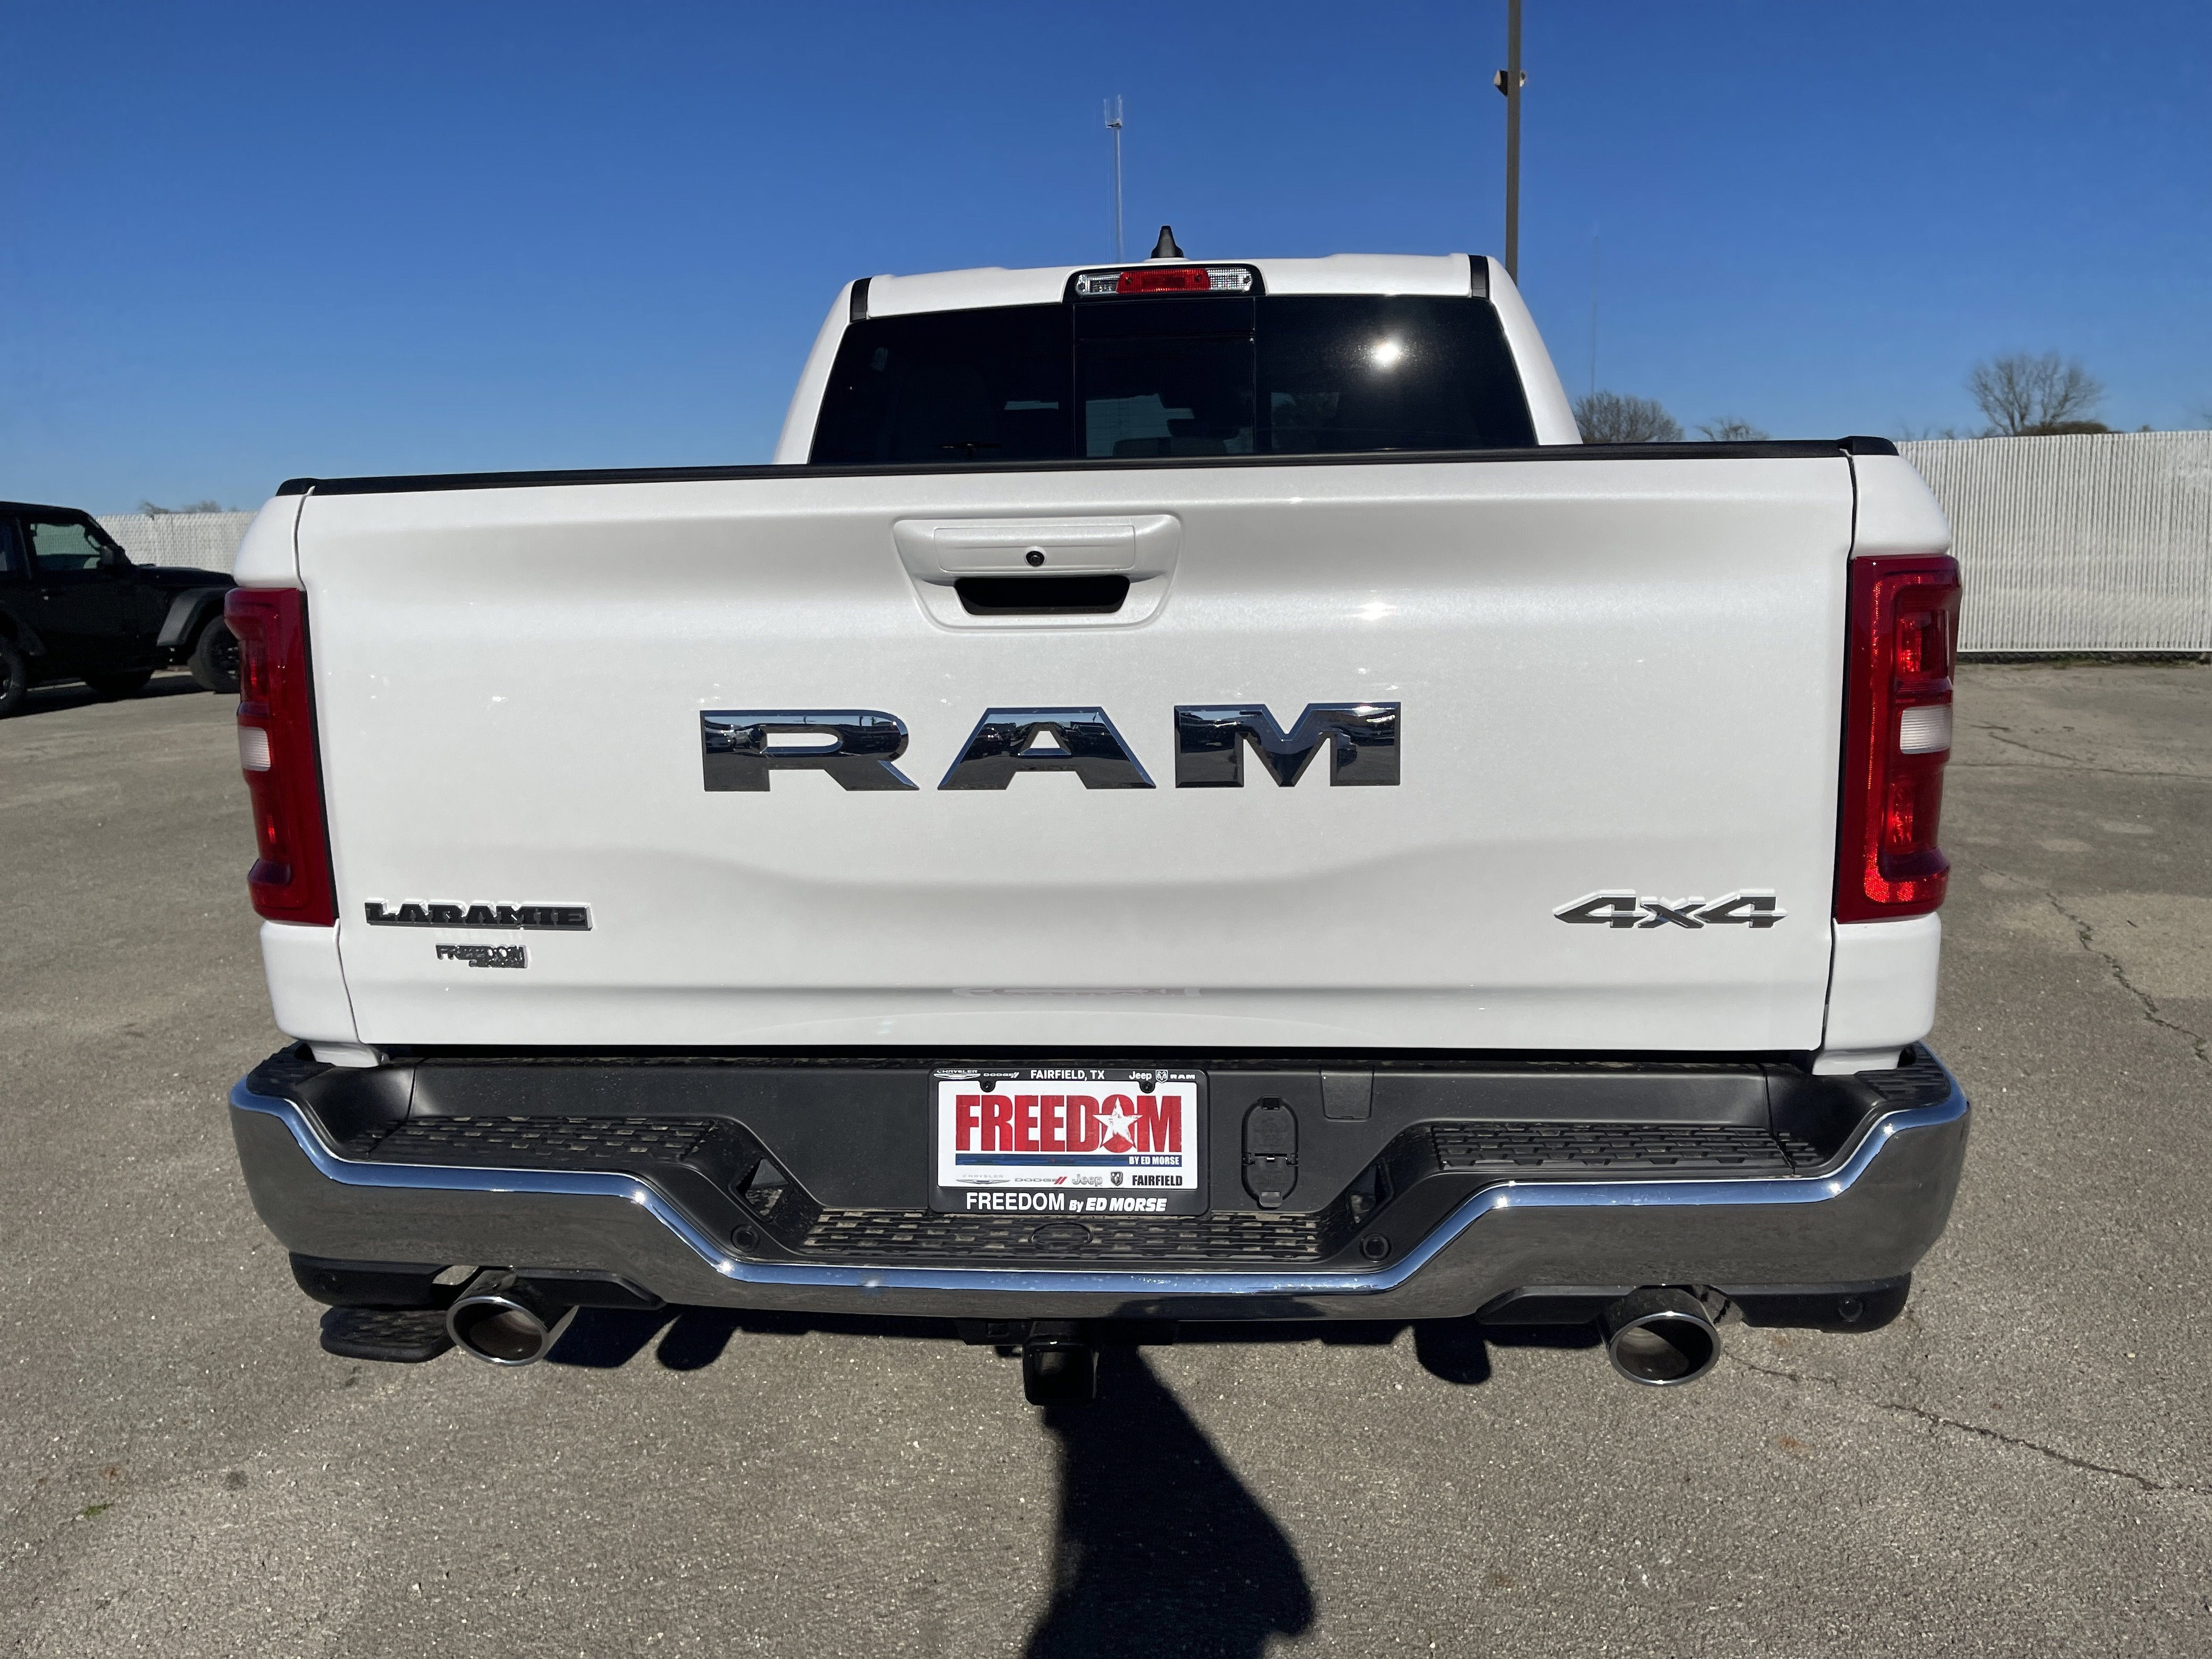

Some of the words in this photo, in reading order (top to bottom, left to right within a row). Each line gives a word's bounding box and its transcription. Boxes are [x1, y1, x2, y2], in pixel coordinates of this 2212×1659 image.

[700, 702, 1401, 792] RAM
[364, 900, 594, 932] LARAMIE
[1030, 1069, 1088, 1081] FAIRFIELD,
[1090, 1070, 1105, 1080] TX
[1128, 1071, 1153, 1080] Jeep
[955, 1093, 1182, 1153] FREEDOM
[1128, 1156, 1139, 1165] BY
[1141, 1156, 1150, 1165] ED
[1152, 1156, 1180, 1165] MORSE
[1071, 1173, 1103, 1187] Jeep
[1132, 1175, 1183, 1186] FAIRFIELD
[966, 1192, 1064, 1211] FREEDOM
[1069, 1199, 1084, 1212] By
[1085, 1197, 1108, 1211] ED
[1109, 1197, 1167, 1212] MORSE
